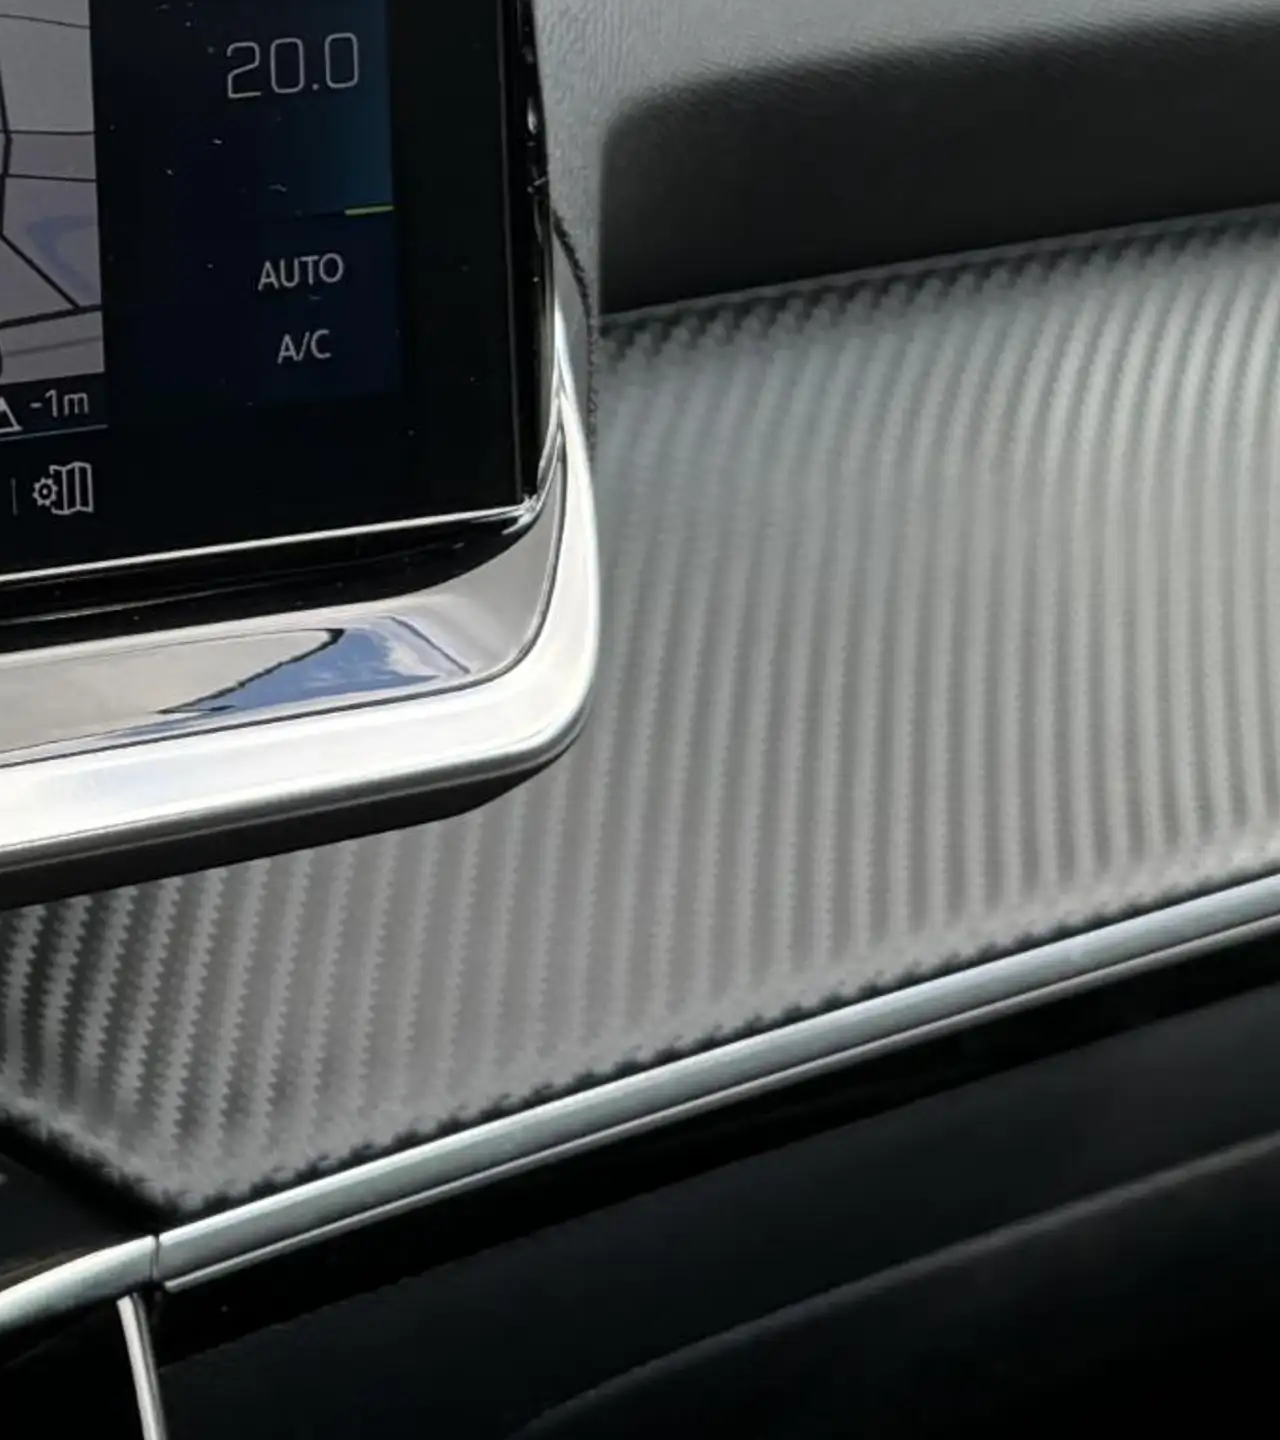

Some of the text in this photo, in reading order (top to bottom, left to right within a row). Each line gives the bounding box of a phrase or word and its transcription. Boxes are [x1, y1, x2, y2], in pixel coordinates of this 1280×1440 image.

[225, 31, 359, 100] 20.0
[256, 251, 345, 292] AUTO
[276, 327, 333, 365] A/C
